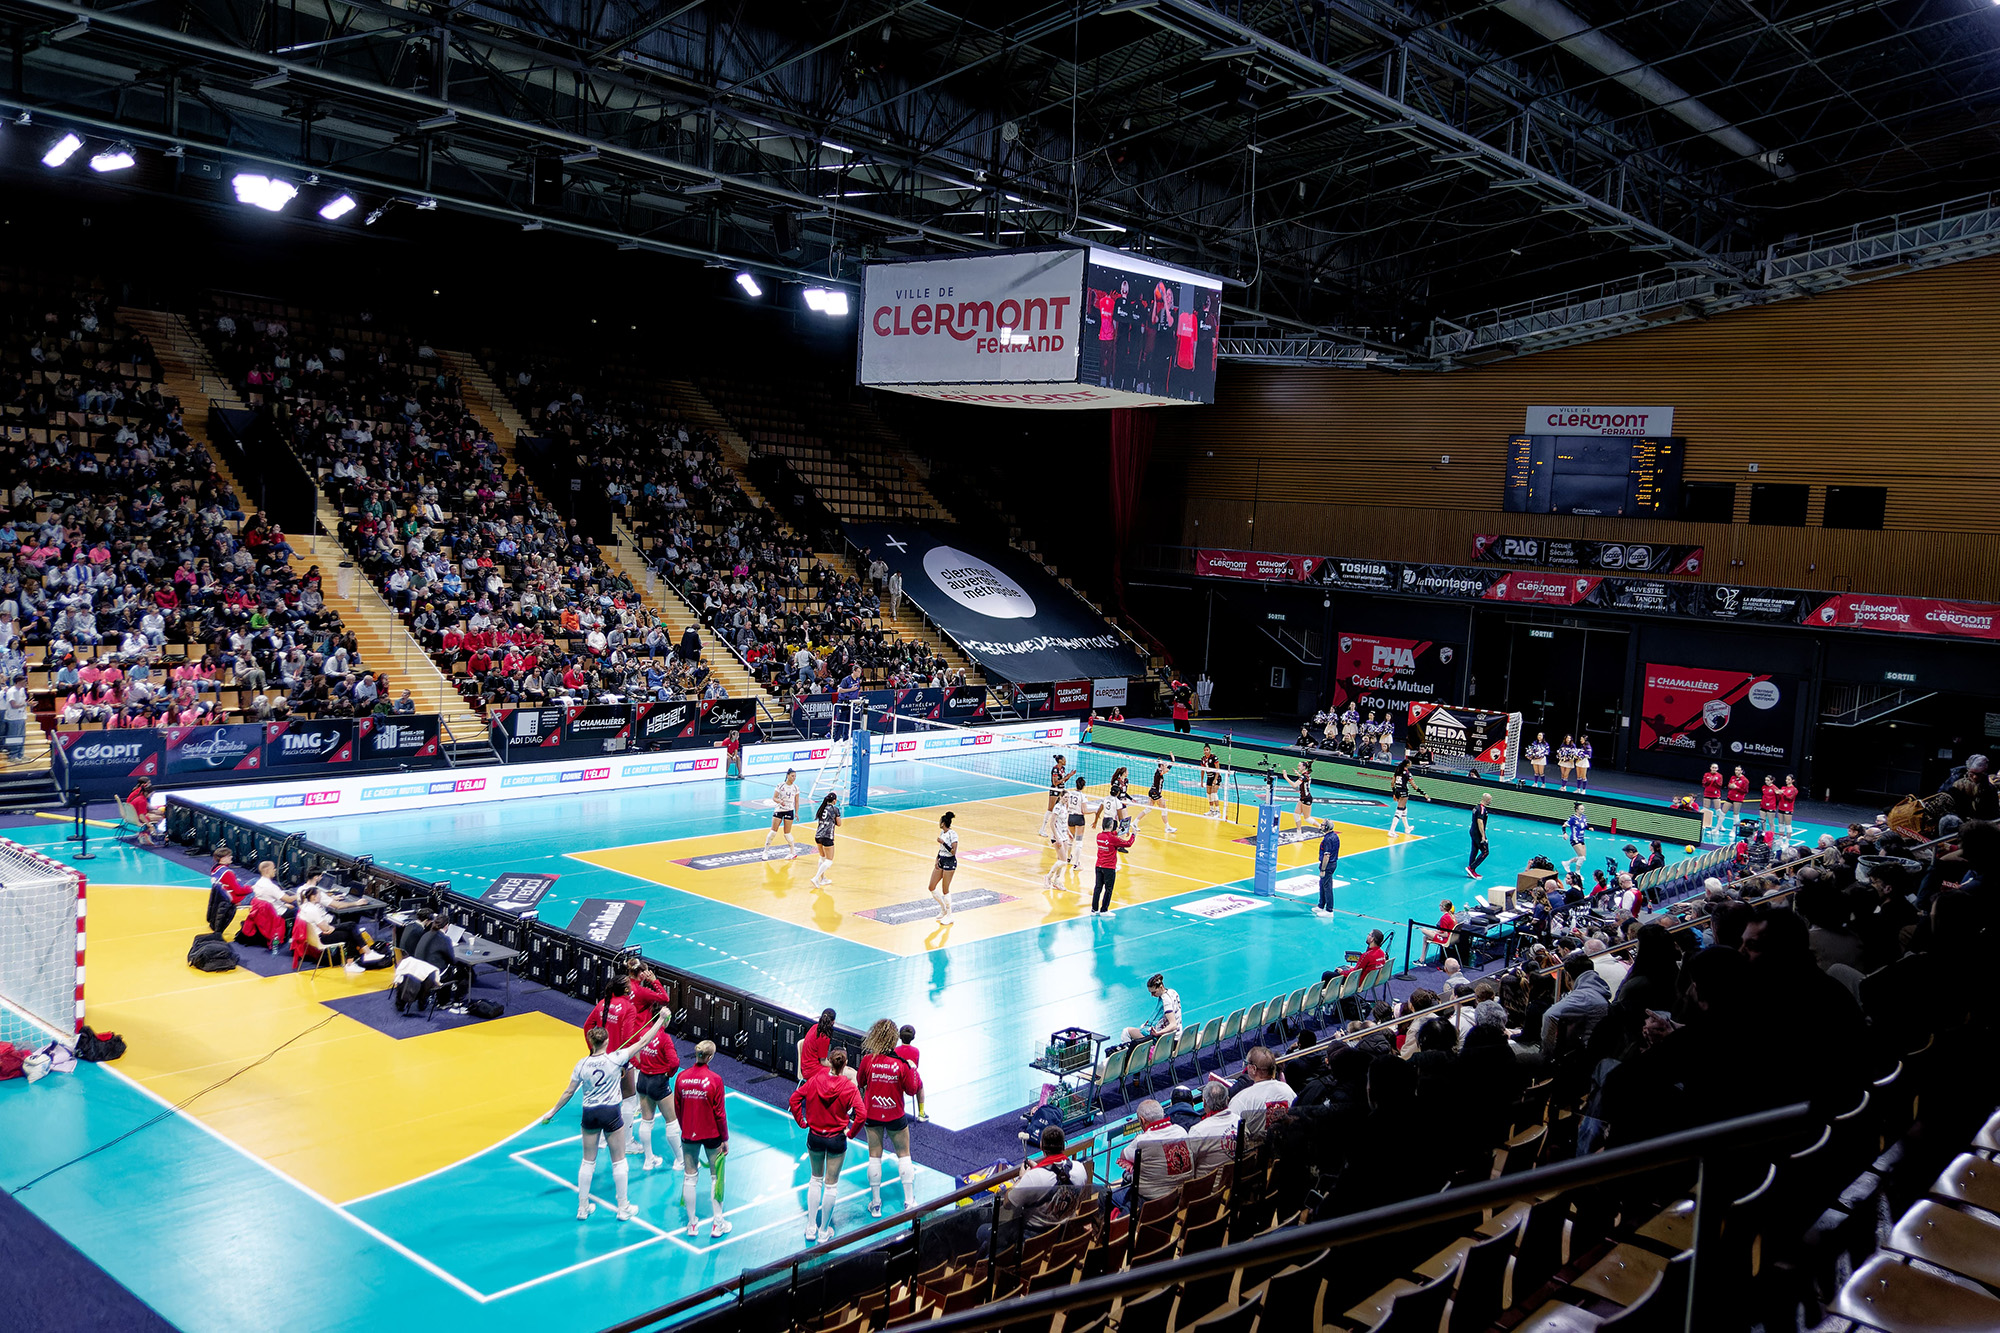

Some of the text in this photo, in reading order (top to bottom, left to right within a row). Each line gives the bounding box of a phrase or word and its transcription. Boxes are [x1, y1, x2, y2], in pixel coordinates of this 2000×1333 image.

[895, 286, 954, 300] VILLE DE
[1504, 539, 1538, 556] PAG
[940, 567, 996, 580] clermont
[1340, 562, 1386, 575] TOSHIBA
[947, 576, 1002, 590] auvergne
[963, 587, 1022, 600] métropole
[1625, 586, 1664, 594] SAUVESTRE
[1849, 603, 1897, 613] CLERMONT
[1854, 612, 1910, 623] 100% SPORT
[1530, 630, 1553, 638] SORTIE
[1372, 645, 1415, 668] PHA
[1371, 665, 1393, 673] Claude
[1886, 672, 1915, 681] SORTIE
[1352, 674, 1434, 694] Crédit Mutuel
[1657, 677, 1719, 690] CHAMALIÈRES
[1073, 694, 1088, 702] SPORT
[1361, 696, 1410, 711] PRO IMM
[580, 716, 625, 726] CHAMALIÈRES
[1425, 725, 1467, 741] MEDA
[282, 733, 322, 749] TMG
[1425, 736, 1467, 746] RÉALISATION
[1755, 743, 1784, 753] Région
[72, 759, 104, 767] AGENCE
[675, 762, 694, 770] DONNE
[696, 759, 718, 769] L'ÉLAN
[502, 769, 609, 786] LE CRÉDIT MUTUEL DONNE L'ÉLAN
[373, 788, 398, 797] CRÉDIT
[398, 786, 425, 795] MUTUEL
[430, 783, 454, 792] DONNE
[458, 779, 485, 791] L'ÉLAN
[239, 799, 270, 808] MUTUEL
[276, 795, 304, 805] DONNE
[308, 792, 340, 804] L'ÉLAN
[1069, 795, 1078, 805] 13
[1105, 801, 1111, 810] 3
[592, 1069, 607, 1087] 2
